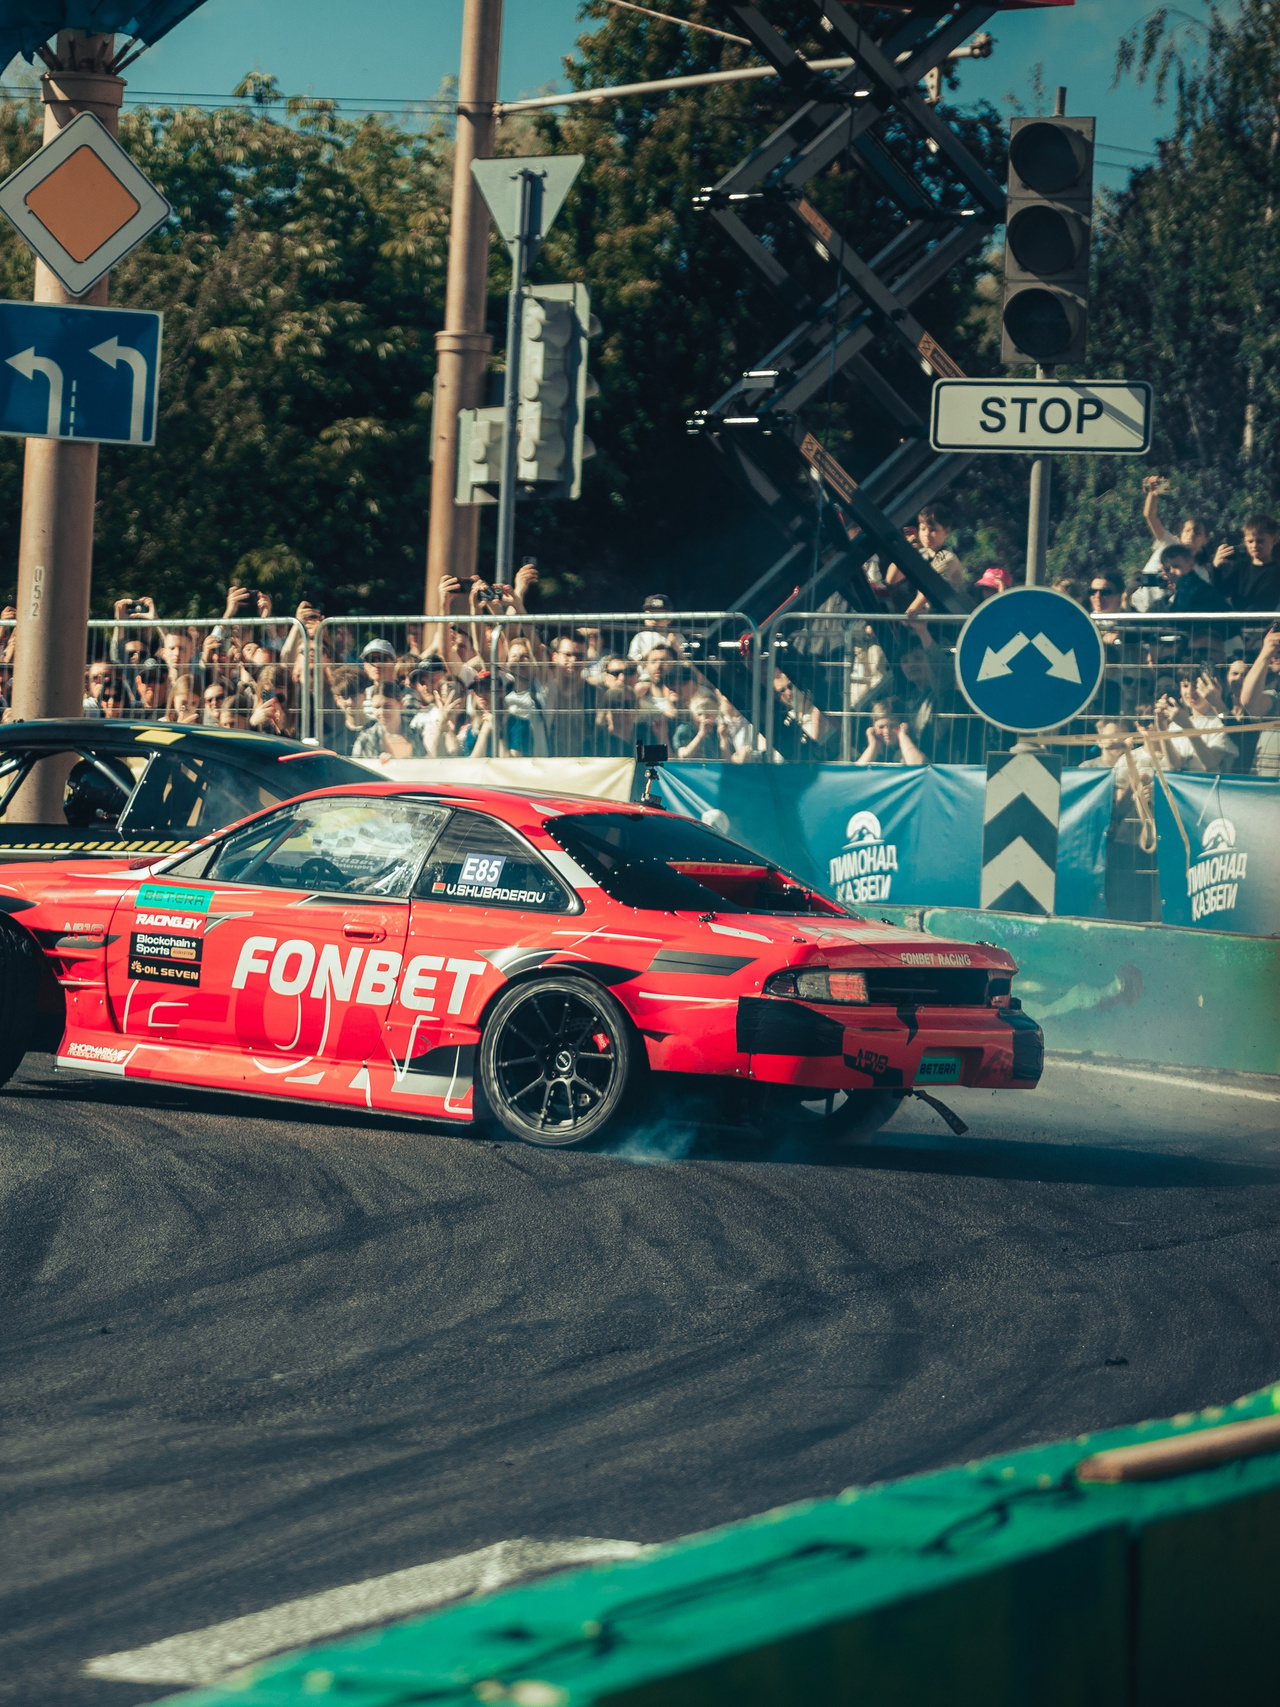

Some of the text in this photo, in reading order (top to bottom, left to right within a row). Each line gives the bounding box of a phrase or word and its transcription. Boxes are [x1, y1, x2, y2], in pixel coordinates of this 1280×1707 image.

[979, 396, 1104, 434] STOP
[32, 567, 43, 617] 052
[461, 857, 502, 882] E85
[829, 844, 898, 887] ЛИМОНАД
[1187, 852, 1248, 898] ЛИМОНАД
[446, 883, 546, 903] V.SHUBADEROV
[836, 874, 892, 903] КАЗБЕГИ
[1192, 882, 1239, 923] КАЗБЕГИ
[136, 933, 191, 948] Blockchain
[136, 943, 170, 956] Sports
[160, 967, 199, 980] SEVEN
[900, 952, 972, 966] FONBET RACING
[231, 936, 488, 1015] FONBET
